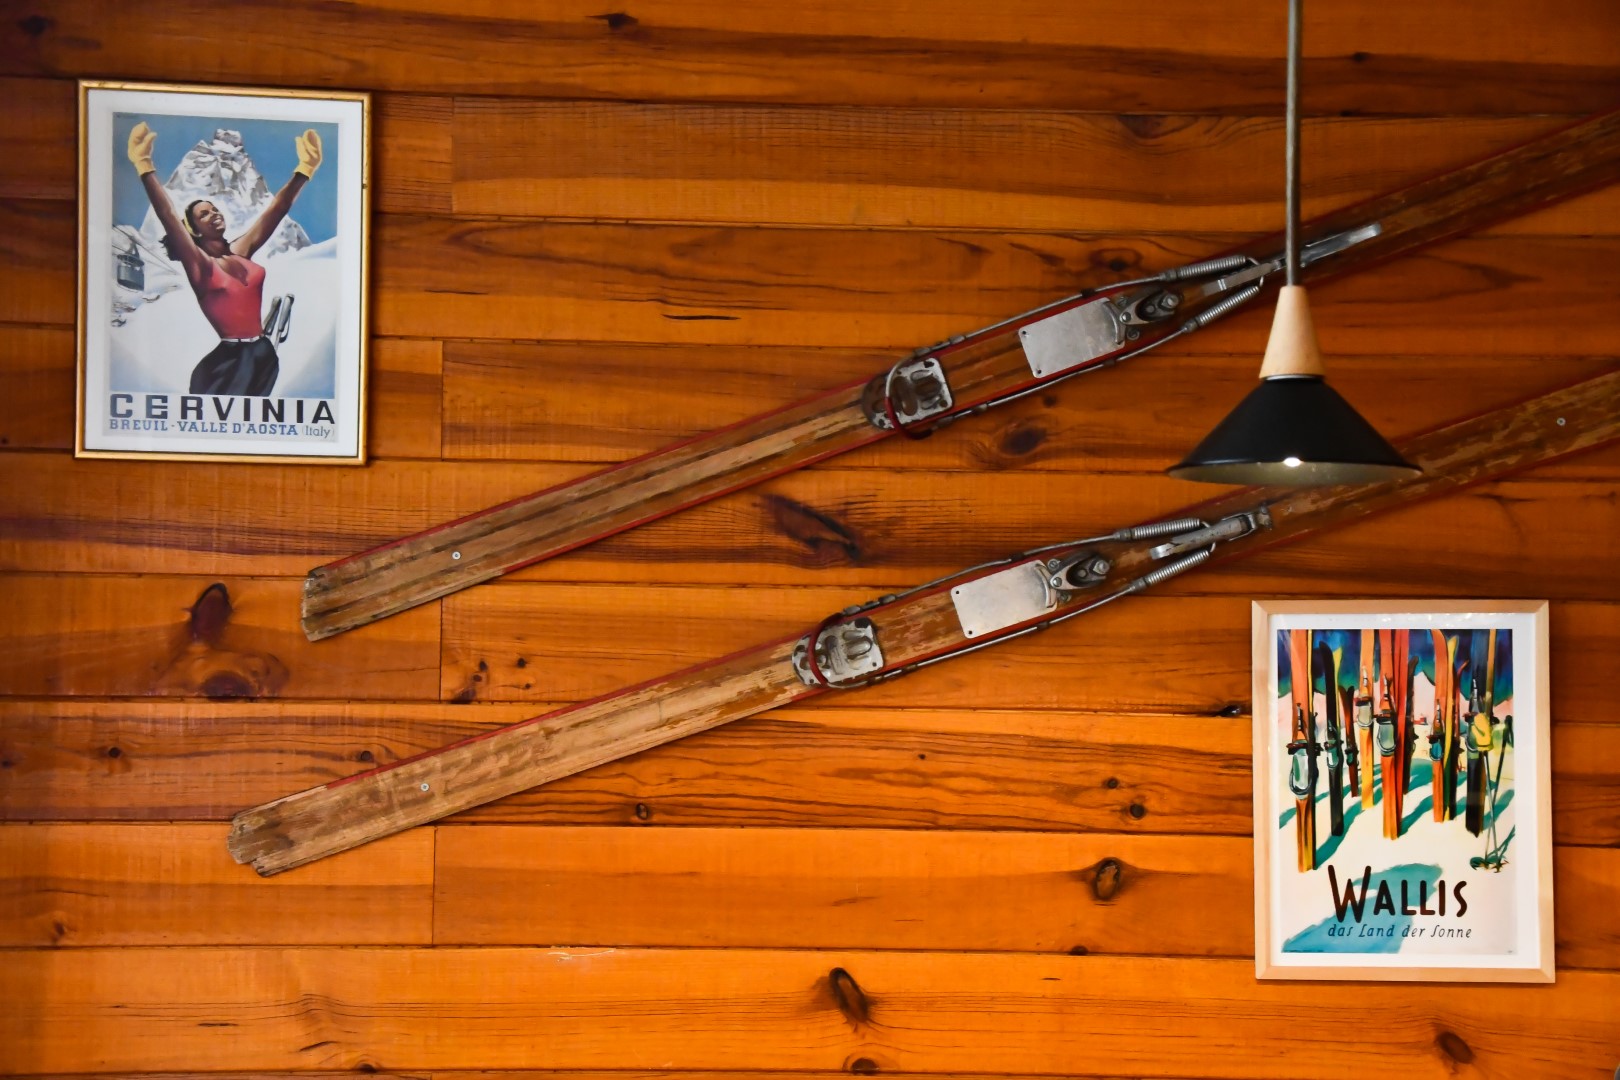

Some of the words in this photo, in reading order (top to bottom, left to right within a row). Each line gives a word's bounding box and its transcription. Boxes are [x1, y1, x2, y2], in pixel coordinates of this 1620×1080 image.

[110, 393, 335, 424] CERVINIA
[232, 423, 298, 436] D'AOSTA
[1327, 864, 1468, 923] WALLIS
[1327, 923, 1353, 937] das
[1358, 923, 1395, 937] Land
[1401, 924, 1425, 938] der
[1430, 924, 1472, 938] Sonne
